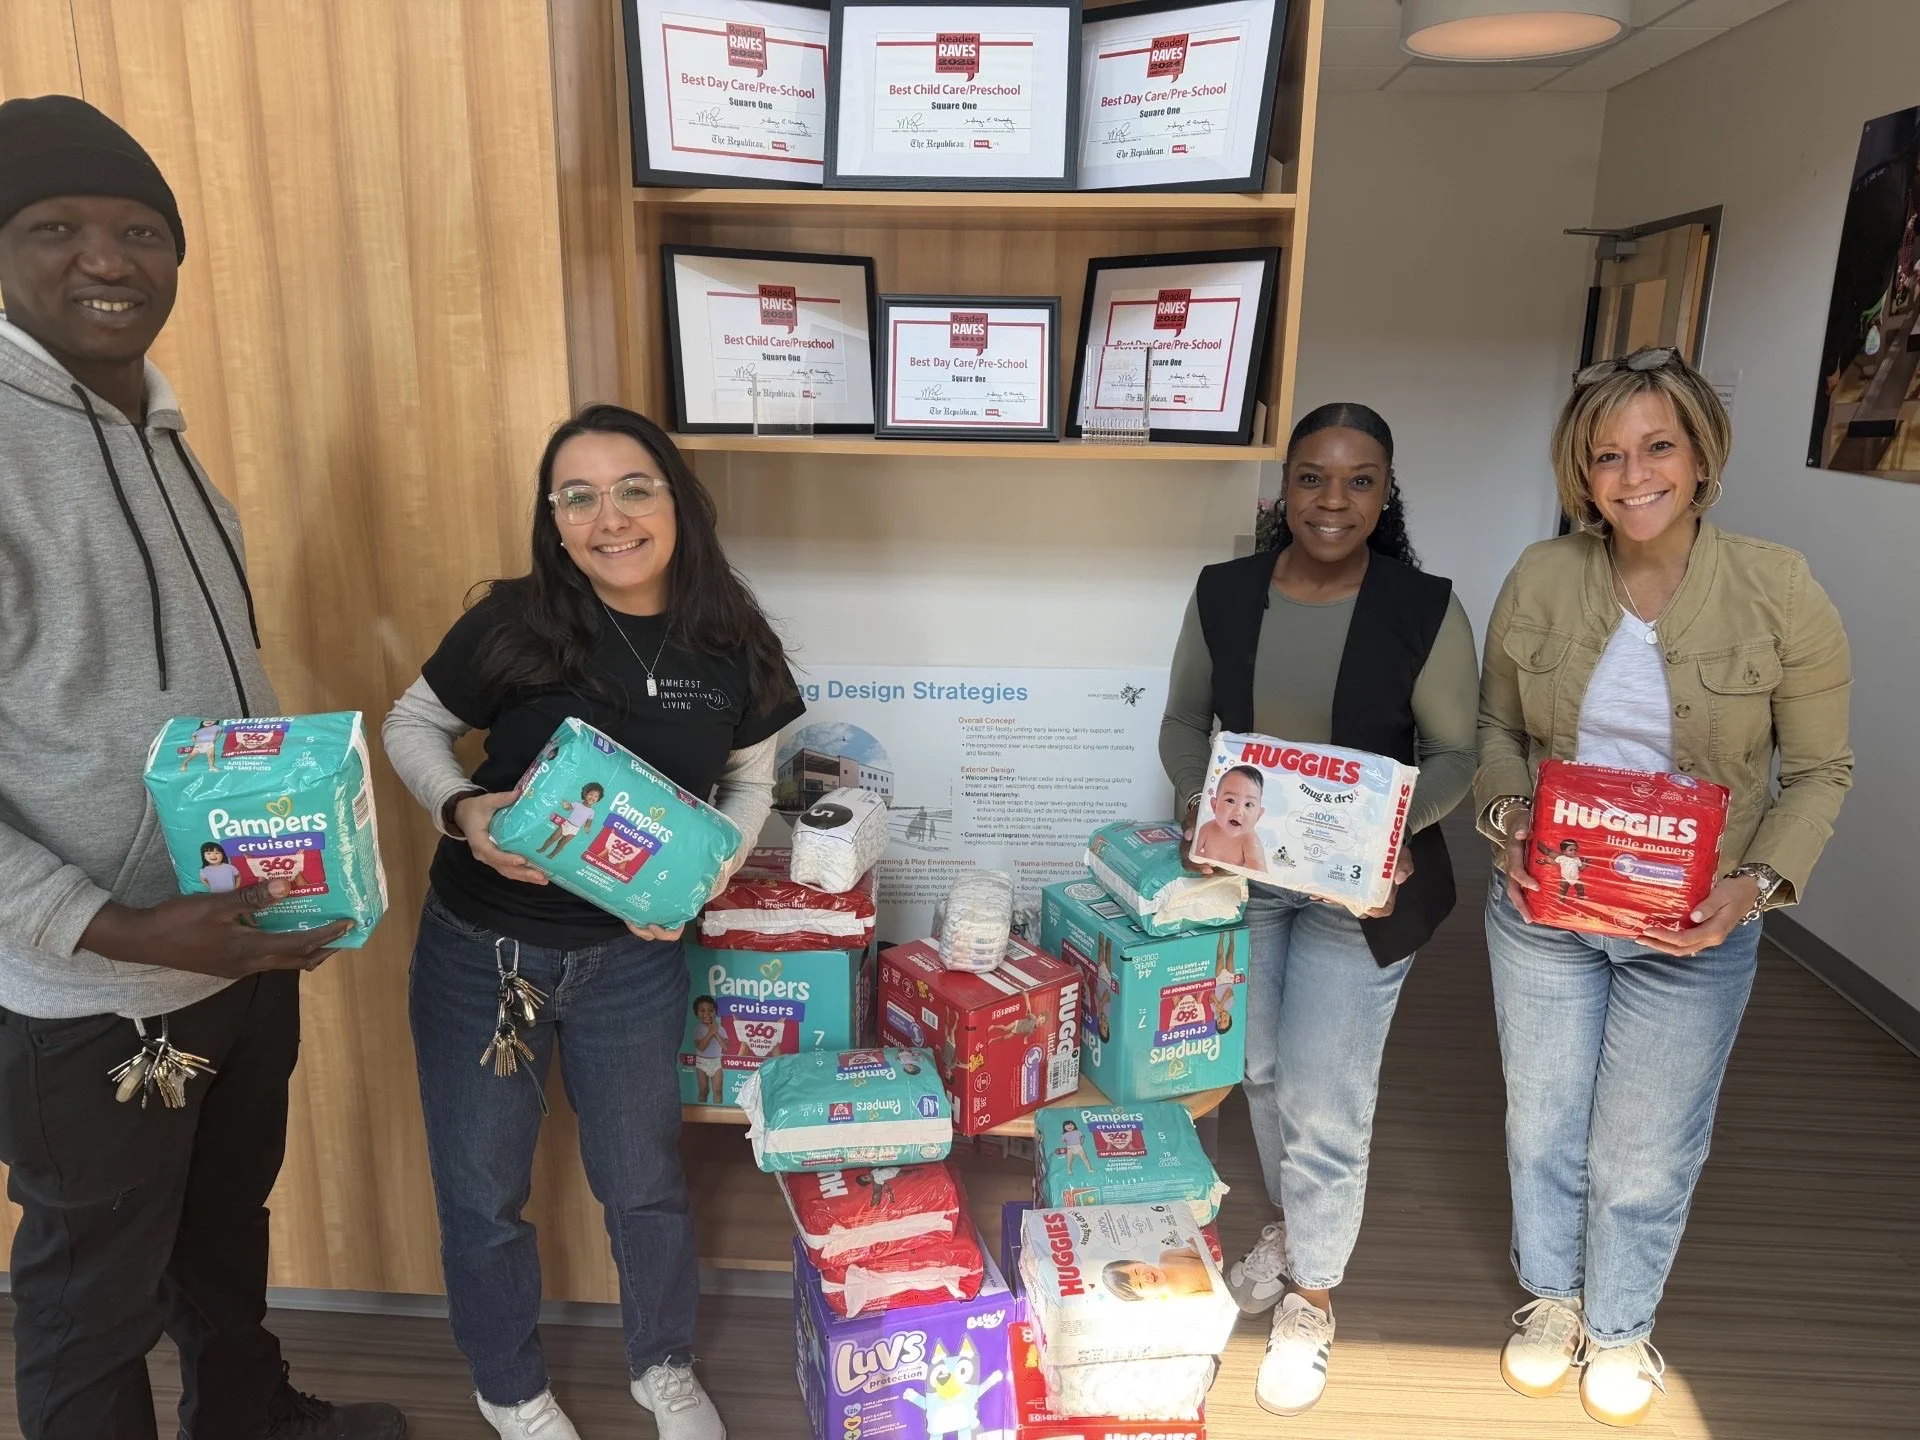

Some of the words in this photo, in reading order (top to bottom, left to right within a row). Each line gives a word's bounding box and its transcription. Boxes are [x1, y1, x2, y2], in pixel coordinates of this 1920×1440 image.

[729, 25, 762, 38] Reader
[730, 37, 762, 50] RAVES
[939, 34, 975, 43] Reader
[1153, 39, 1185, 49] Reader
[939, 44, 975, 56] RAVES
[1152, 47, 1183, 62] RAVES
[1150, 61, 1182, 69] 2024
[682, 73, 705, 86] Best
[708, 76, 728, 91] Day
[731, 80, 815, 99] Care/Pre-School
[889, 85, 911, 95] Best
[914, 85, 940, 95] Child
[943, 85, 1021, 95] Care/Preschool
[1101, 95, 1122, 107] Best
[1124, 94, 1142, 105] Day
[1145, 83, 1227, 102] Care/Pre-School
[729, 97, 756, 108] Square
[758, 101, 772, 109] One
[932, 102, 960, 110] Square
[1140, 109, 1165, 118] Square
[1167, 107, 1180, 115] One
[712, 134, 725, 144] The
[910, 139, 925, 148] The
[1117, 150, 1128, 158] The
[762, 288, 792, 298] Reader
[1160, 292, 1187, 301] Reader
[762, 299, 793, 310] RAVES
[1158, 302, 1185, 314] RAVES
[953, 315, 984, 323] Reader
[952, 324, 984, 335] RAVES
[724, 335, 744, 345] Best
[746, 336, 768, 346] Child
[771, 337, 834, 349] Care/Preschool
[1153, 339, 1222, 350] Care/Pre-School
[762, 353, 786, 361] Square
[910, 357, 930, 366] Best
[934, 358, 950, 369] Day
[954, 358, 1028, 370] Care/Pre-School
[660, 679, 700, 688] AMHERST
[828, 680, 905, 703] Design
[913, 681, 1028, 704] Strategies
[663, 702, 691, 710] LIVING
[958, 716, 984, 724] Overall
[985, 717, 1016, 726] Concept
[1241, 742, 1360, 785] HUGGIES
[631, 759, 676, 795] Pampers
[961, 766, 989, 774] Exterior
[991, 766, 1015, 775] Design
[1299, 783, 1324, 802] snug
[1324, 794, 1332, 803] &
[1335, 793, 1354, 803] dry
[609, 791, 673, 843] Pampers
[811, 809, 834, 819] 5
[1315, 812, 1339, 824] 100%
[208, 809, 327, 840] Pampers
[1554, 799, 1698, 844] HUGGIES
[614, 821, 654, 848] cruisers
[1382, 783, 1411, 880] HUGGIES
[239, 838, 312, 852] cruisers
[1607, 835, 1640, 850] little
[1643, 843, 1695, 858] movers
[876, 859, 903, 867] earning
[911, 859, 926, 867] Play
[928, 859, 976, 867] Environments
[658, 870, 668, 880] 6
[1350, 865, 1361, 879] 3
[1132, 953, 1159, 963] COUCHES
[1134, 961, 1156, 970] DIAPERS
[883, 968, 888, 982] 8
[1138, 970, 1152, 979] 44
[708, 965, 810, 1002] Pampers
[730, 1003, 794, 1016] cruisers
[1138, 1015, 1147, 1029] 7
[813, 1030, 825, 1046] 7
[1162, 1026, 1208, 1041] cruisers
[1150, 1034, 1220, 1064] Pampers
[844, 1063, 882, 1071] cruisers
[836, 1067, 897, 1081] Pampers
[856, 1099, 901, 1115] Pampers
[978, 1113, 991, 1126] 8
[1081, 1110, 1144, 1124] Pampers
[1043, 1212, 1085, 1297] HUGGIES
[1022, 1329, 1033, 1342] 8
[870, 1371, 922, 1388] protection
